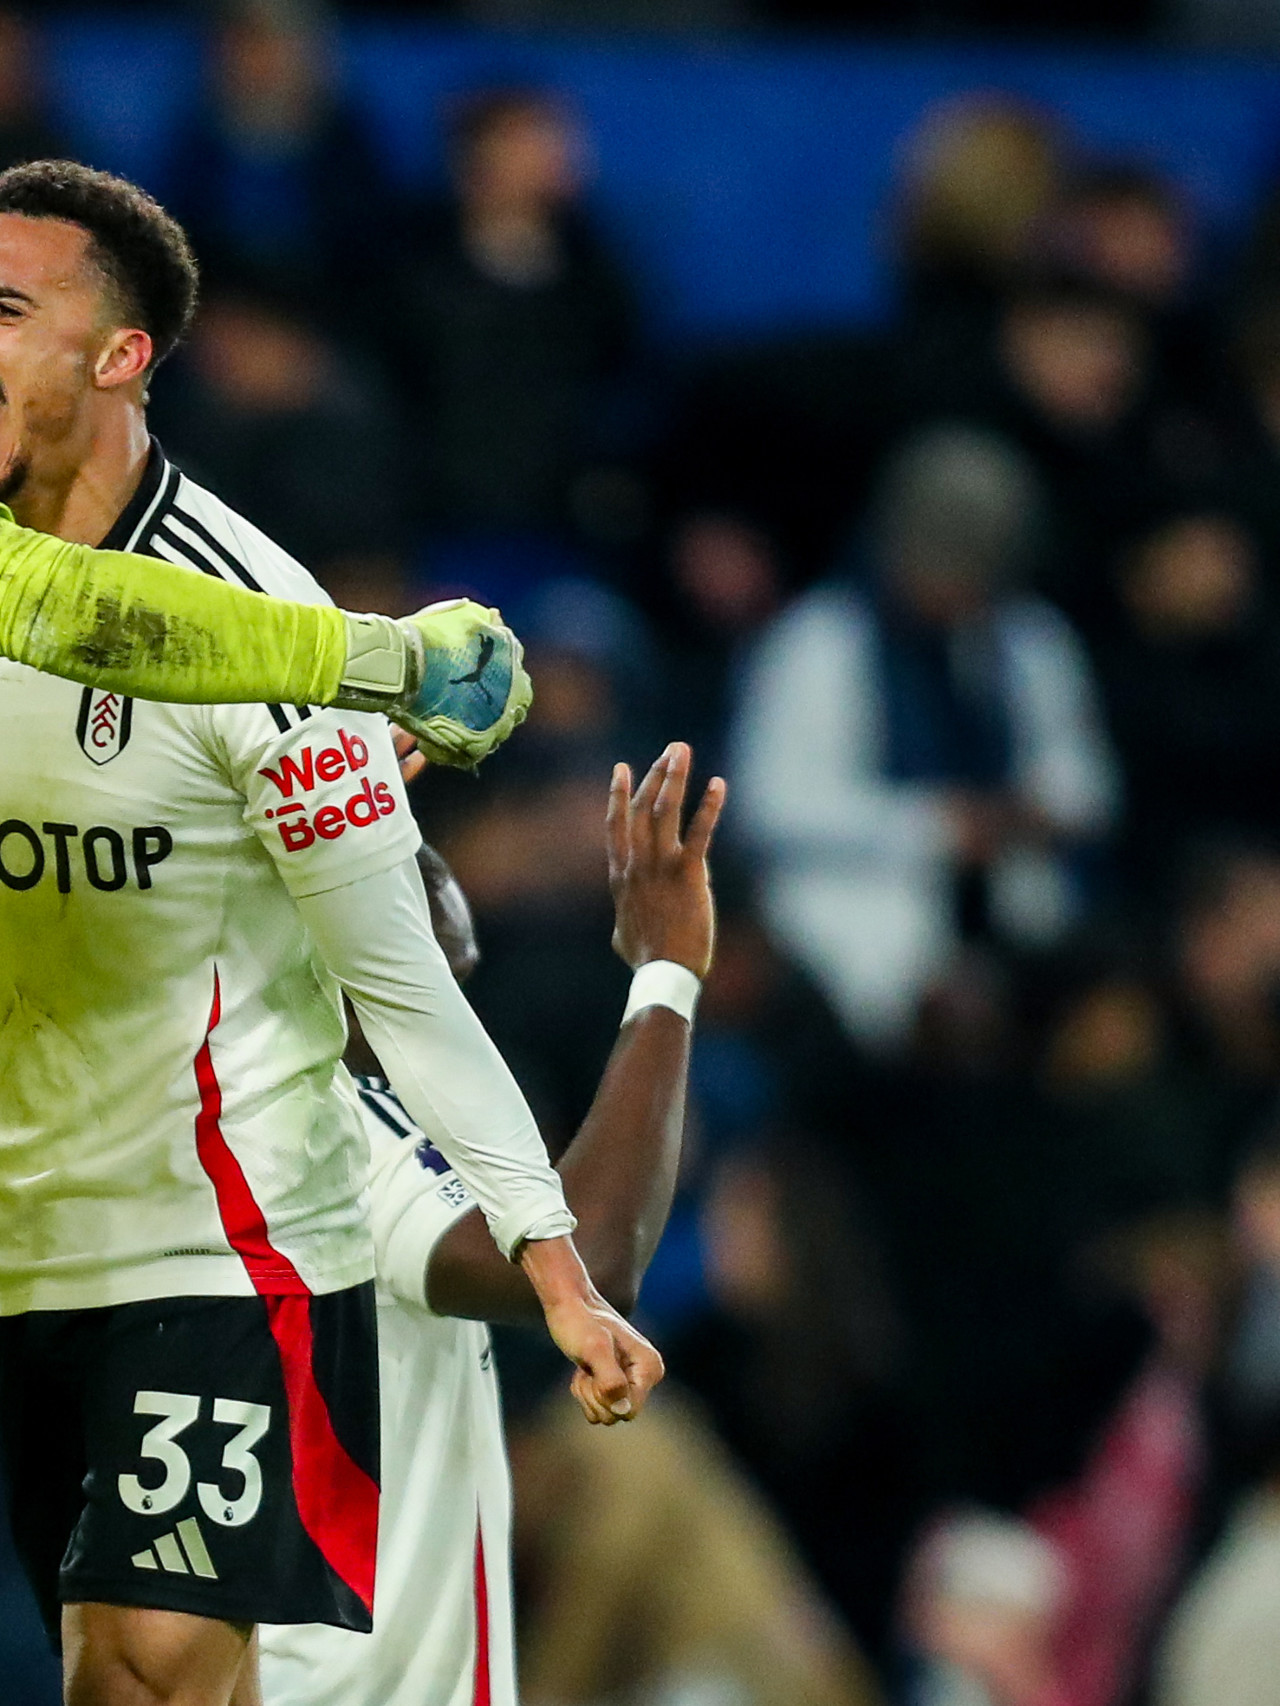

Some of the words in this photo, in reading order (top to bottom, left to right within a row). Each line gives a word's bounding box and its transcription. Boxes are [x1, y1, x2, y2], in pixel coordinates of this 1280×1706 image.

[91, 693, 120, 748] FFC
[258, 728, 369, 798] Web
[118, 1390, 271, 1527] 33
